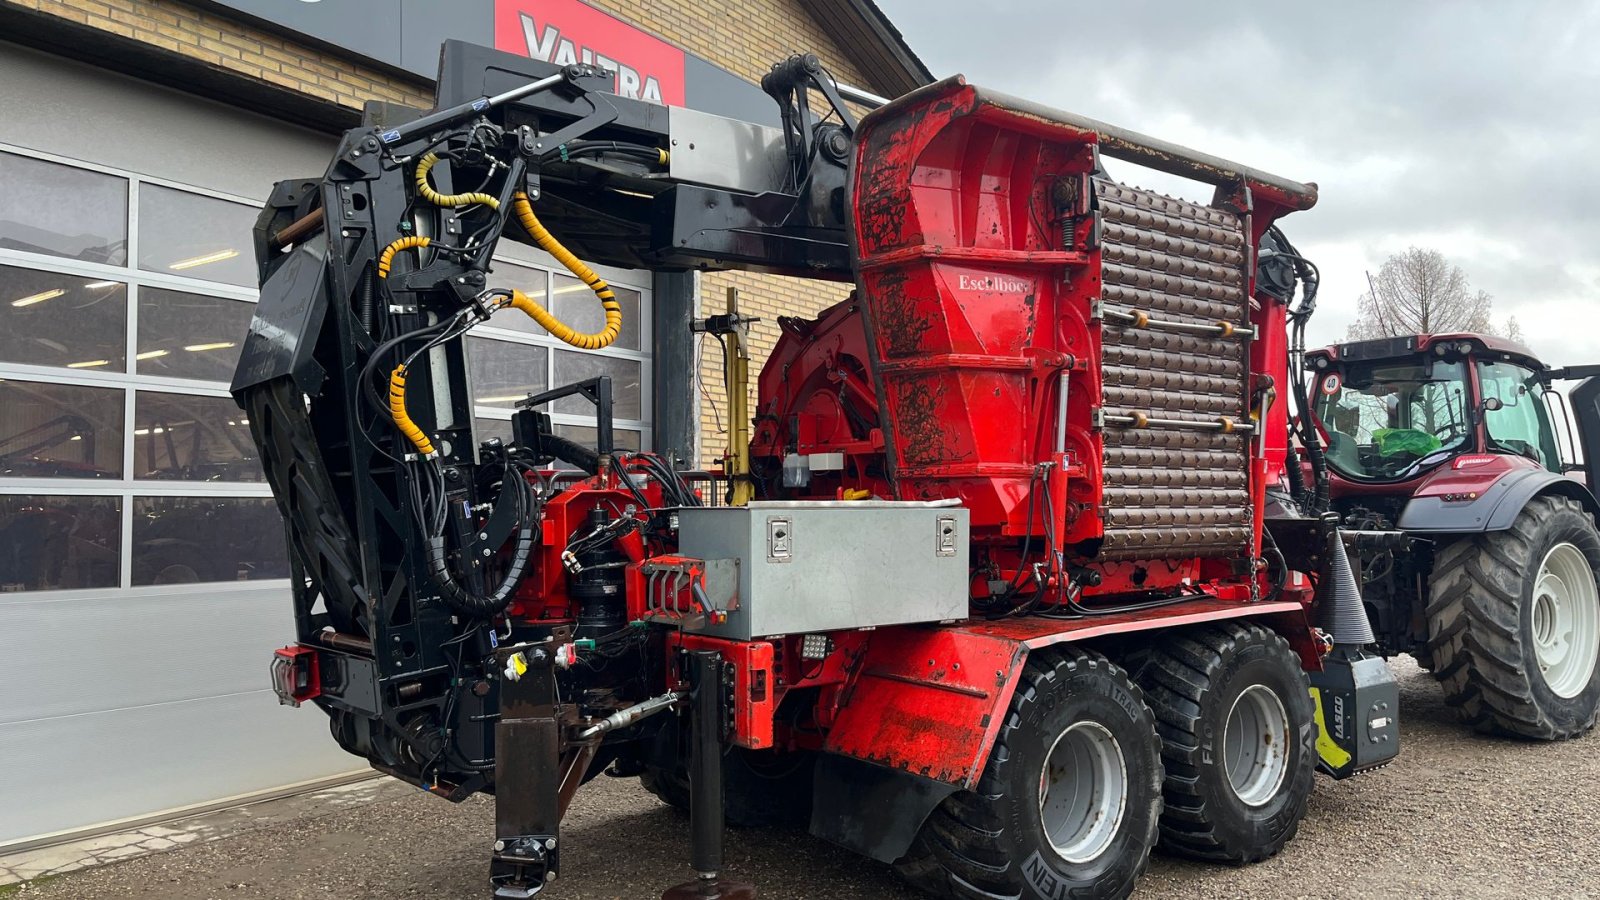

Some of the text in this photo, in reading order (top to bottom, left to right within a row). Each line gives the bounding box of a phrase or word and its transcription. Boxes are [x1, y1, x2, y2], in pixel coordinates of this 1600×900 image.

[959, 275, 1029, 292] Eschlböc
[1327, 378, 1336, 388] 40
[1114, 686, 1137, 721] TRAC
